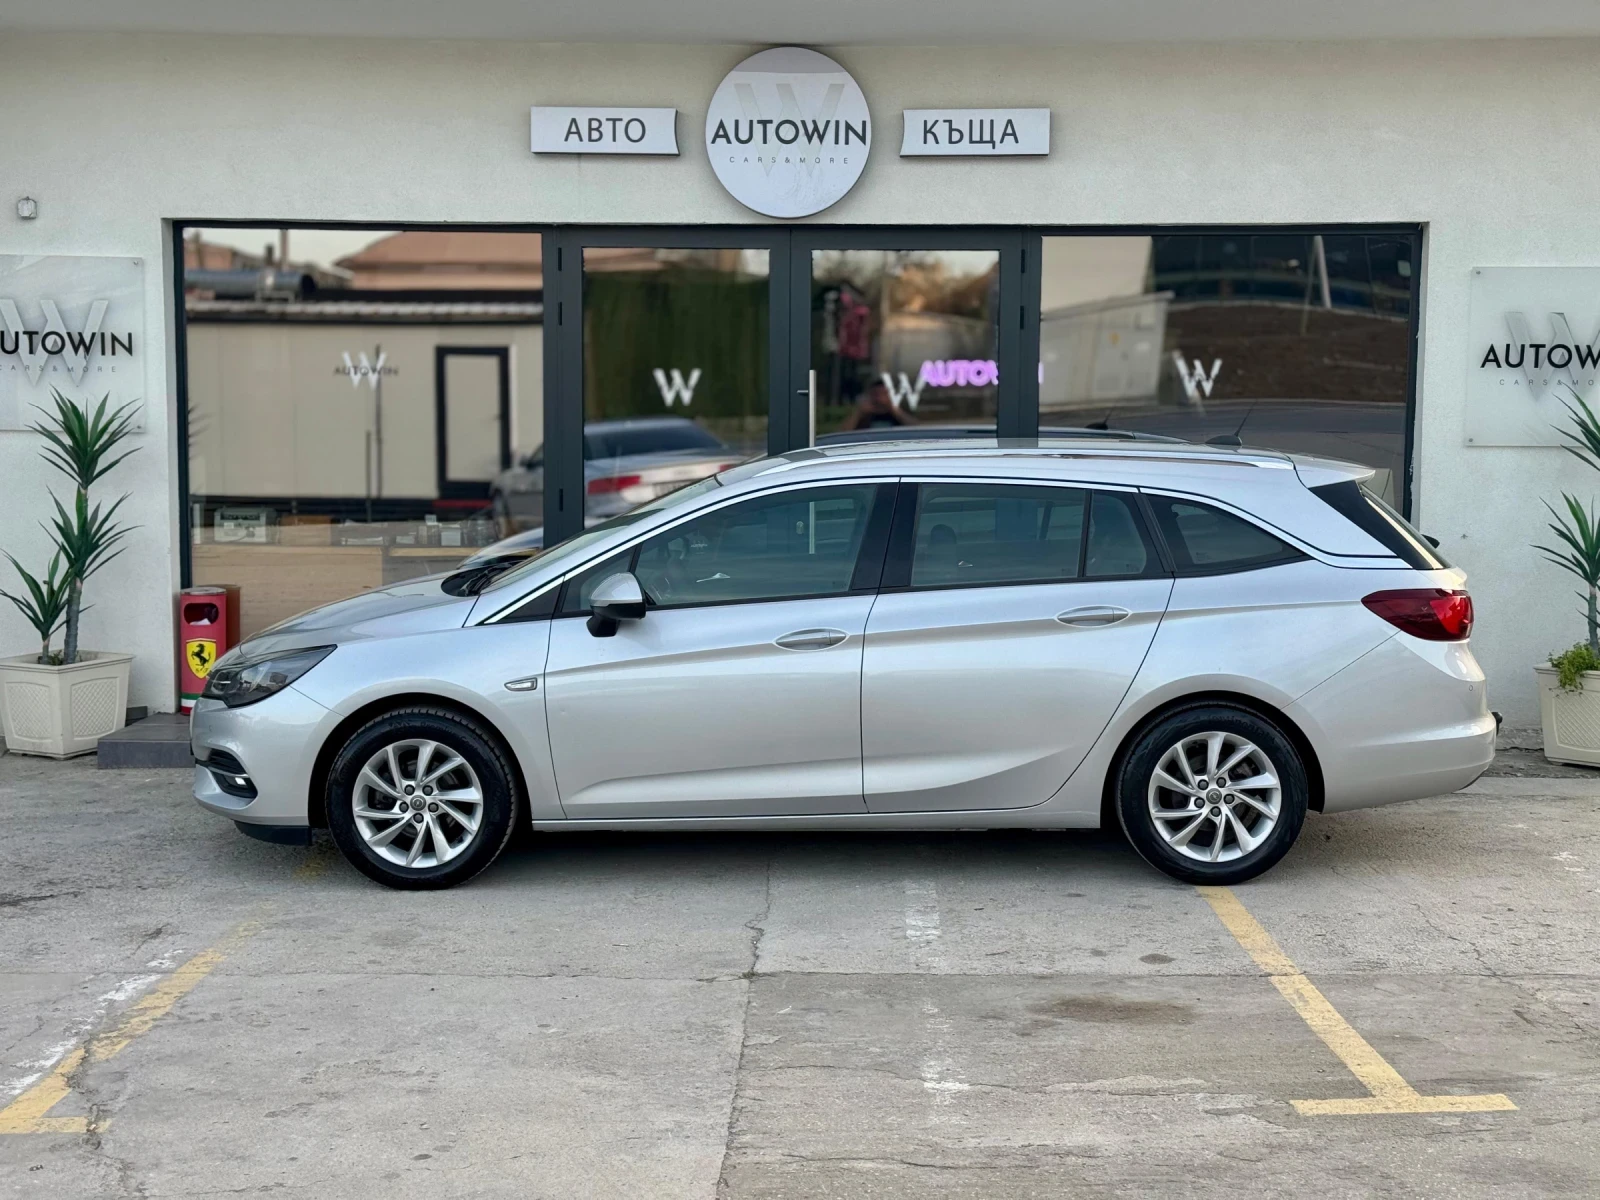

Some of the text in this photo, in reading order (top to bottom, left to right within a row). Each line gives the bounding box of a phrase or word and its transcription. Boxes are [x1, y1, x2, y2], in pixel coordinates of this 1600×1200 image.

[563, 117, 647, 143] АВТО
[710, 118, 868, 146] AUTOWIN
[923, 118, 1019, 150] КЪЩА
[0, 330, 133, 356] UTOWIN
[1480, 343, 1600, 370] AUTOW
[652, 367, 702, 407] W
[881, 372, 928, 411] W
[1174, 357, 1223, 398] W
